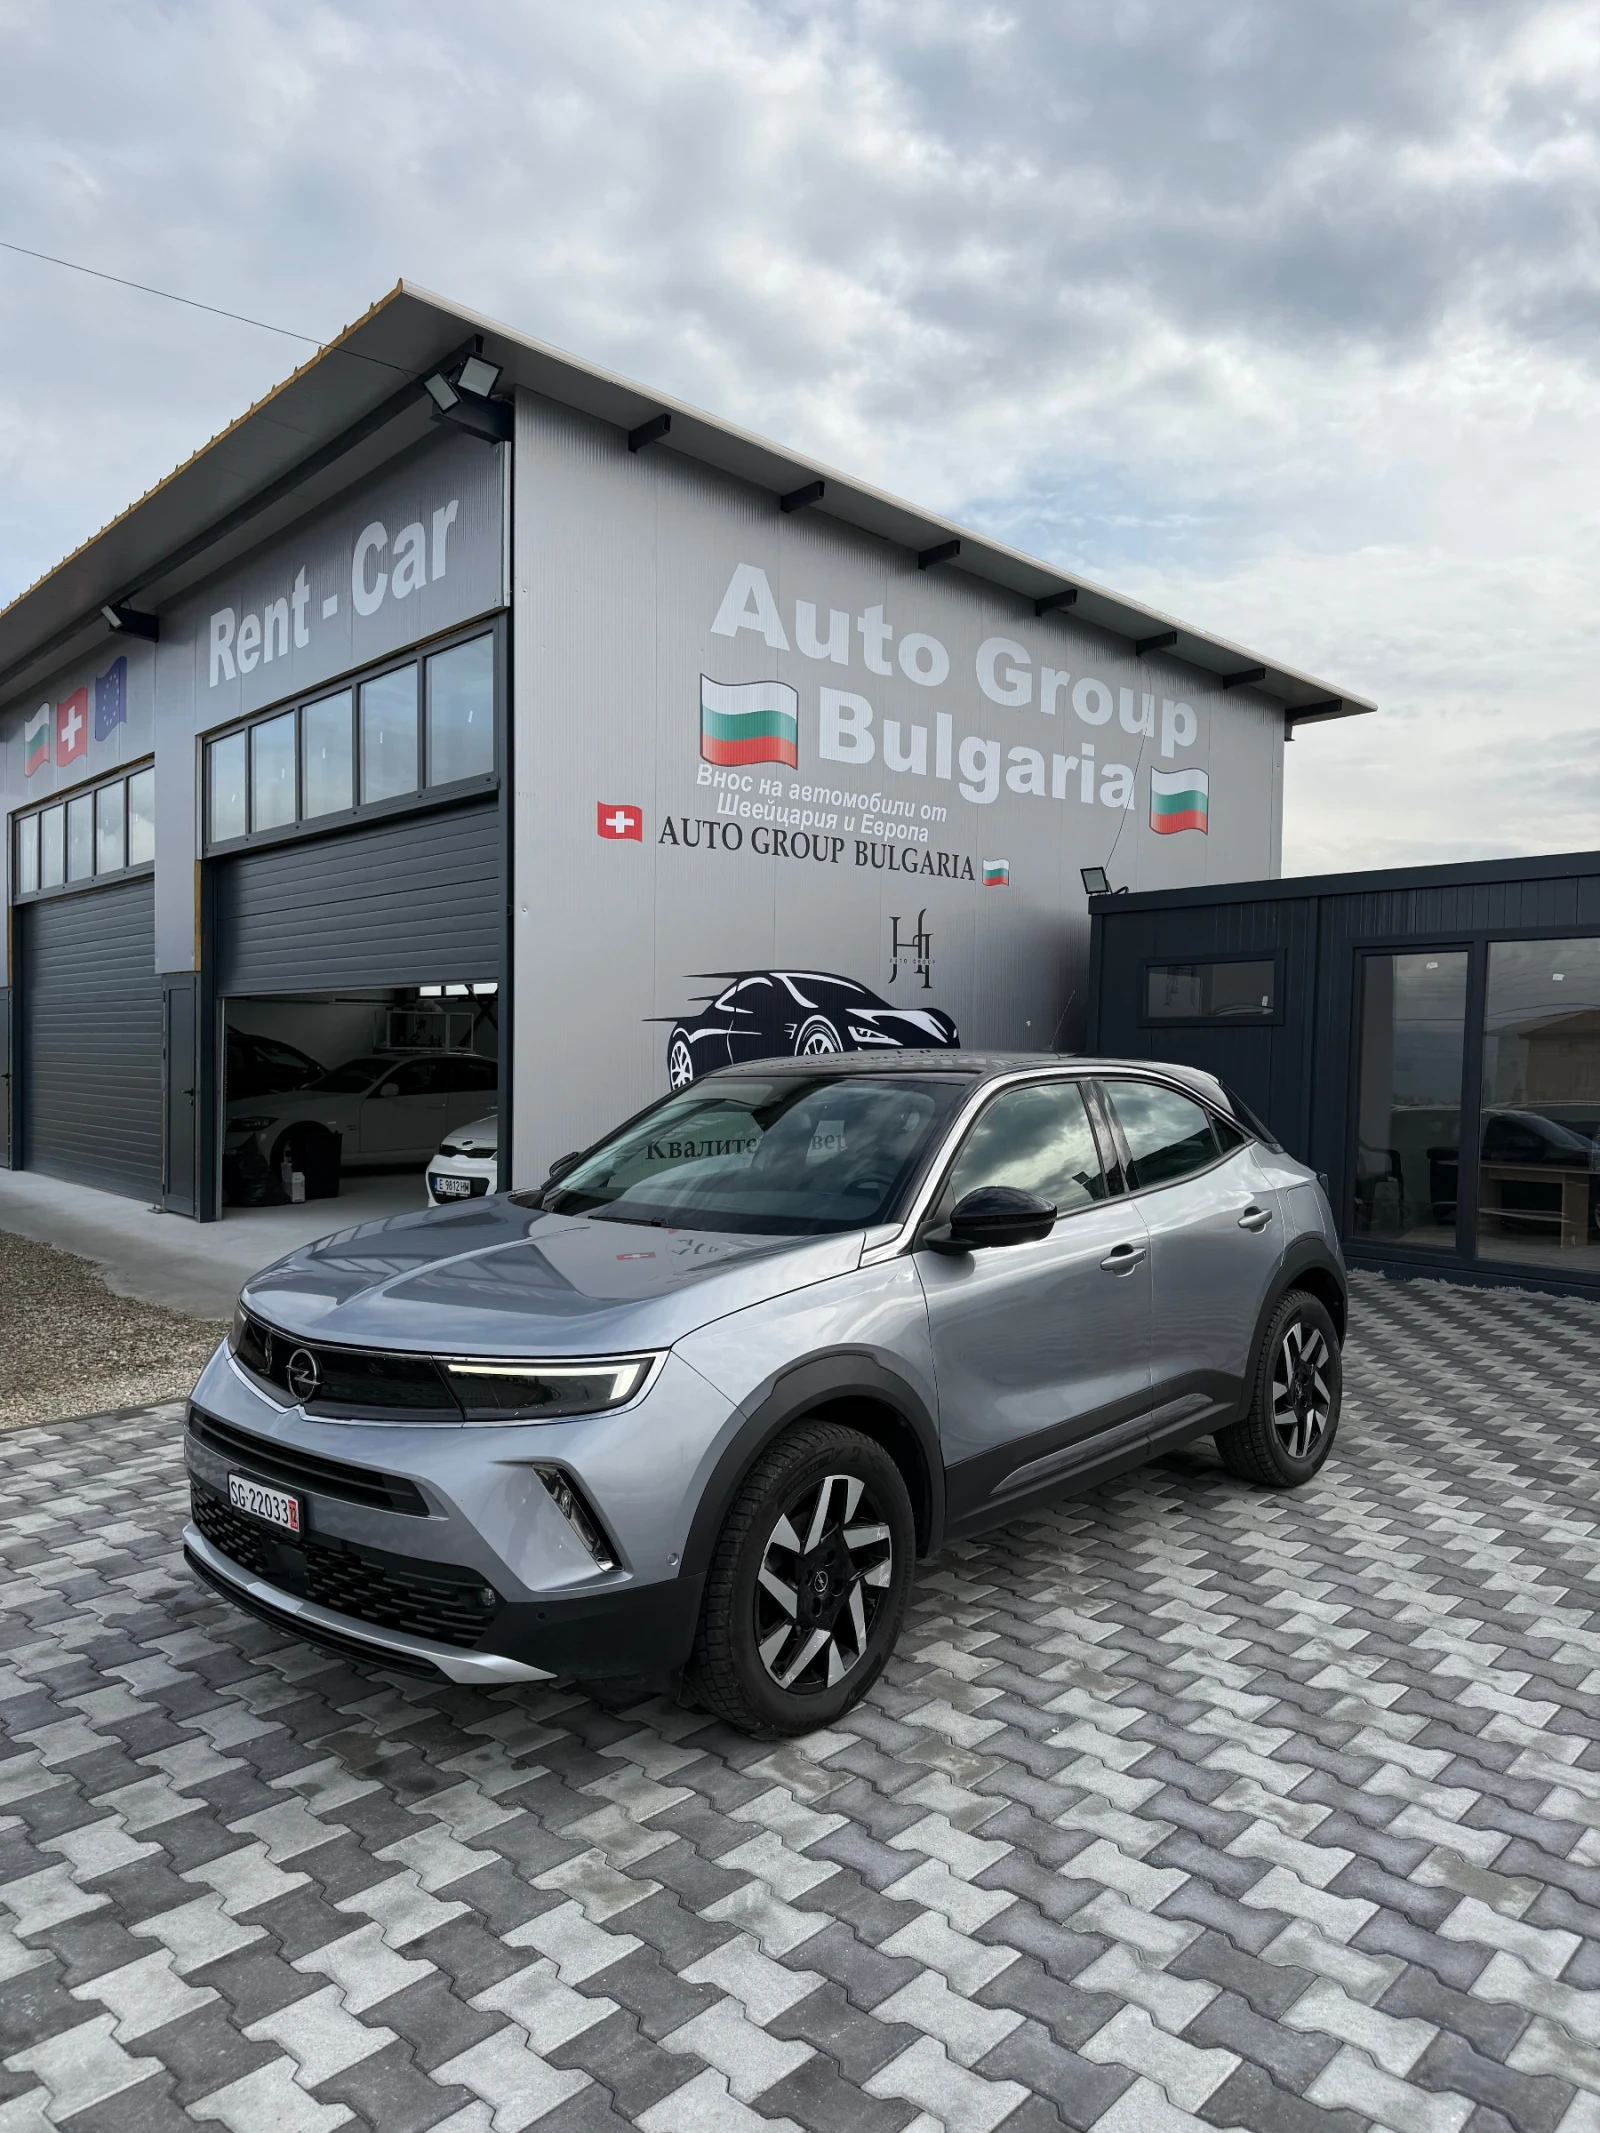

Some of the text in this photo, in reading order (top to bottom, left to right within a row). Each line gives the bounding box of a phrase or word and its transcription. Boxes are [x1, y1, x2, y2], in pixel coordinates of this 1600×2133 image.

[209, 564, 310, 688] Rent
[351, 499, 459, 617] Car
[710, 562, 1198, 758] Auto Group
[696, 763, 947, 823] Внос на автомобили от
[819, 686, 1135, 811] Bulgaria
[658, 815, 976, 881] AUTO GROUP BULGARIA
[716, 792, 929, 843] Швейцария и Европа
